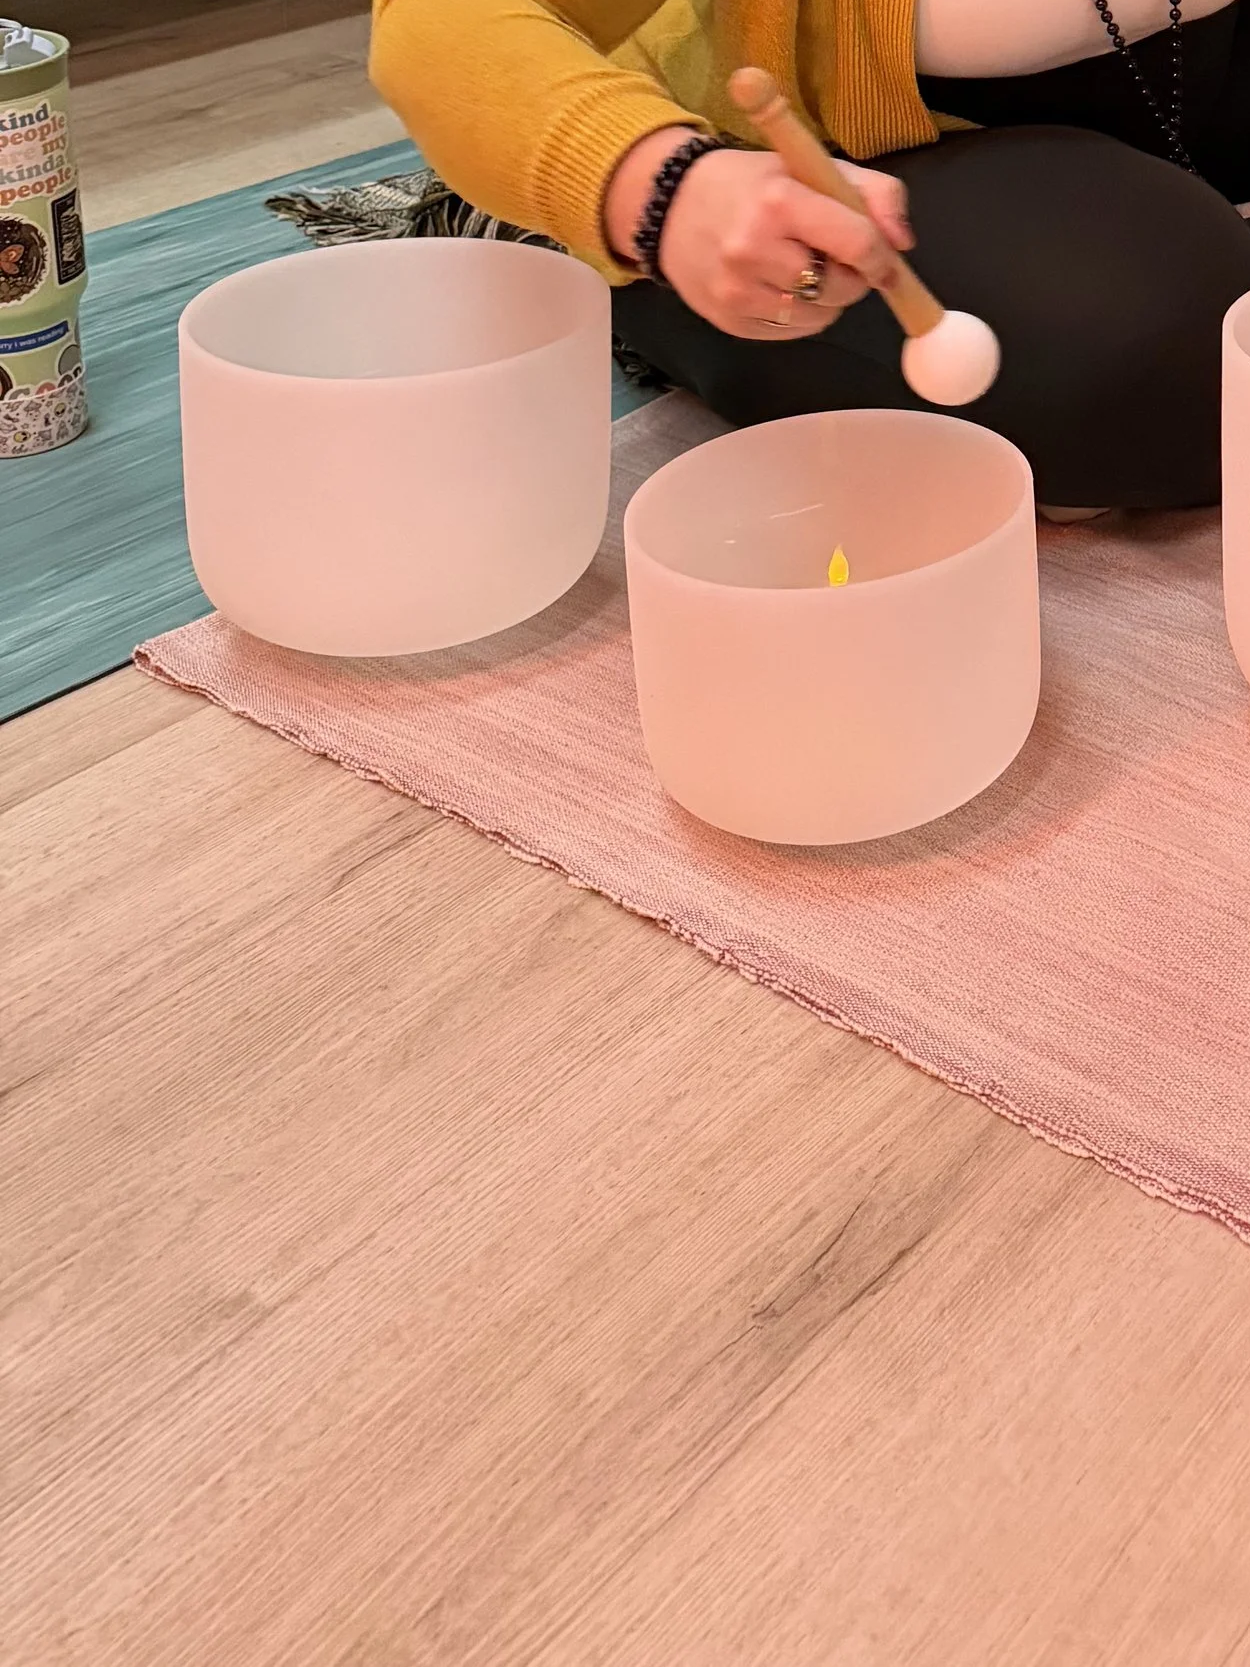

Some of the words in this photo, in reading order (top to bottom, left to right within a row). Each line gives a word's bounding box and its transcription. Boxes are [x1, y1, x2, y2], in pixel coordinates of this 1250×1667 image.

[42, 133, 67, 155] my
[0, 154, 66, 185] kinda
[0, 166, 72, 206] people
